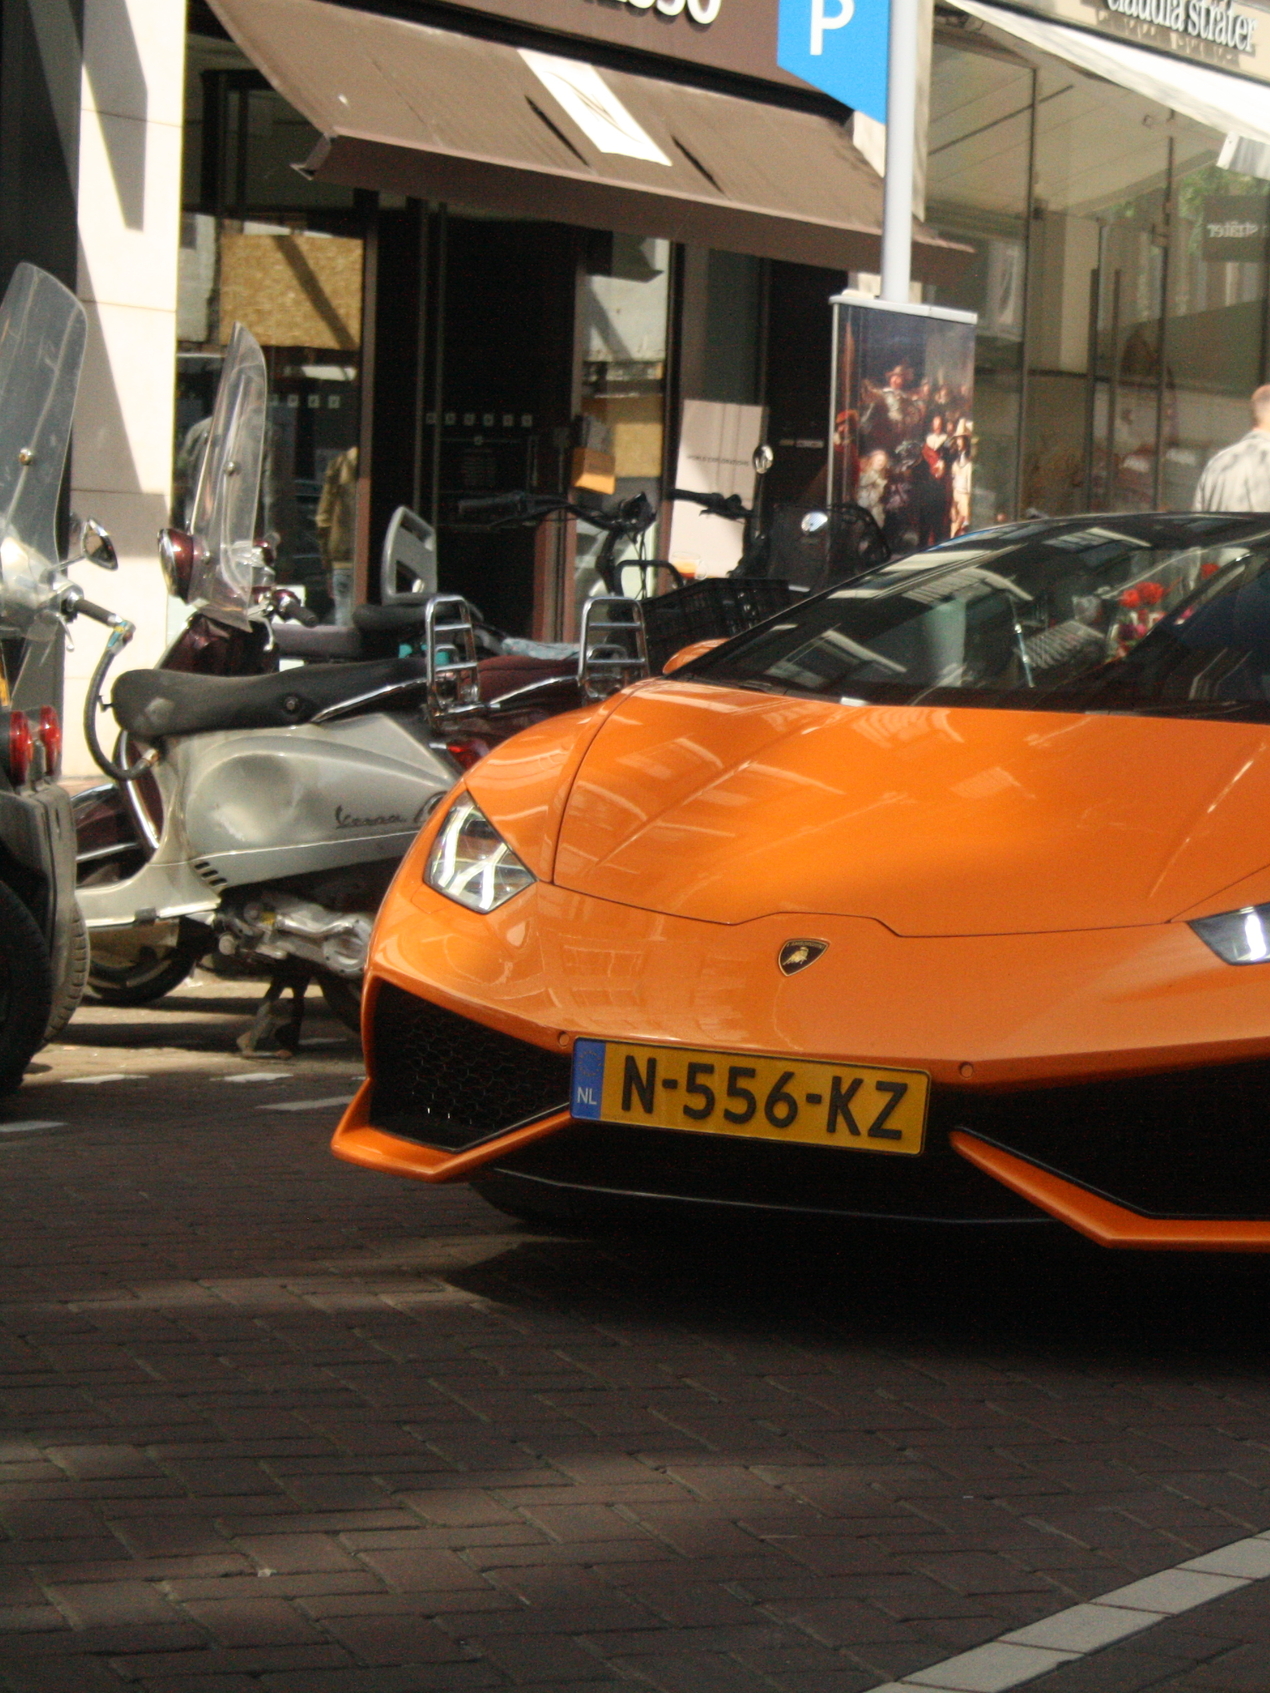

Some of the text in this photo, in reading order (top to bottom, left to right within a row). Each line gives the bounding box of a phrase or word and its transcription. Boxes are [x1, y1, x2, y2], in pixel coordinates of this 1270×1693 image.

[810, 0, 855, 55] P
[1108, 0, 1185, 32] udia
[577, 1086, 597, 1105] NL
[621, 1055, 908, 1140] N-556-KZ
